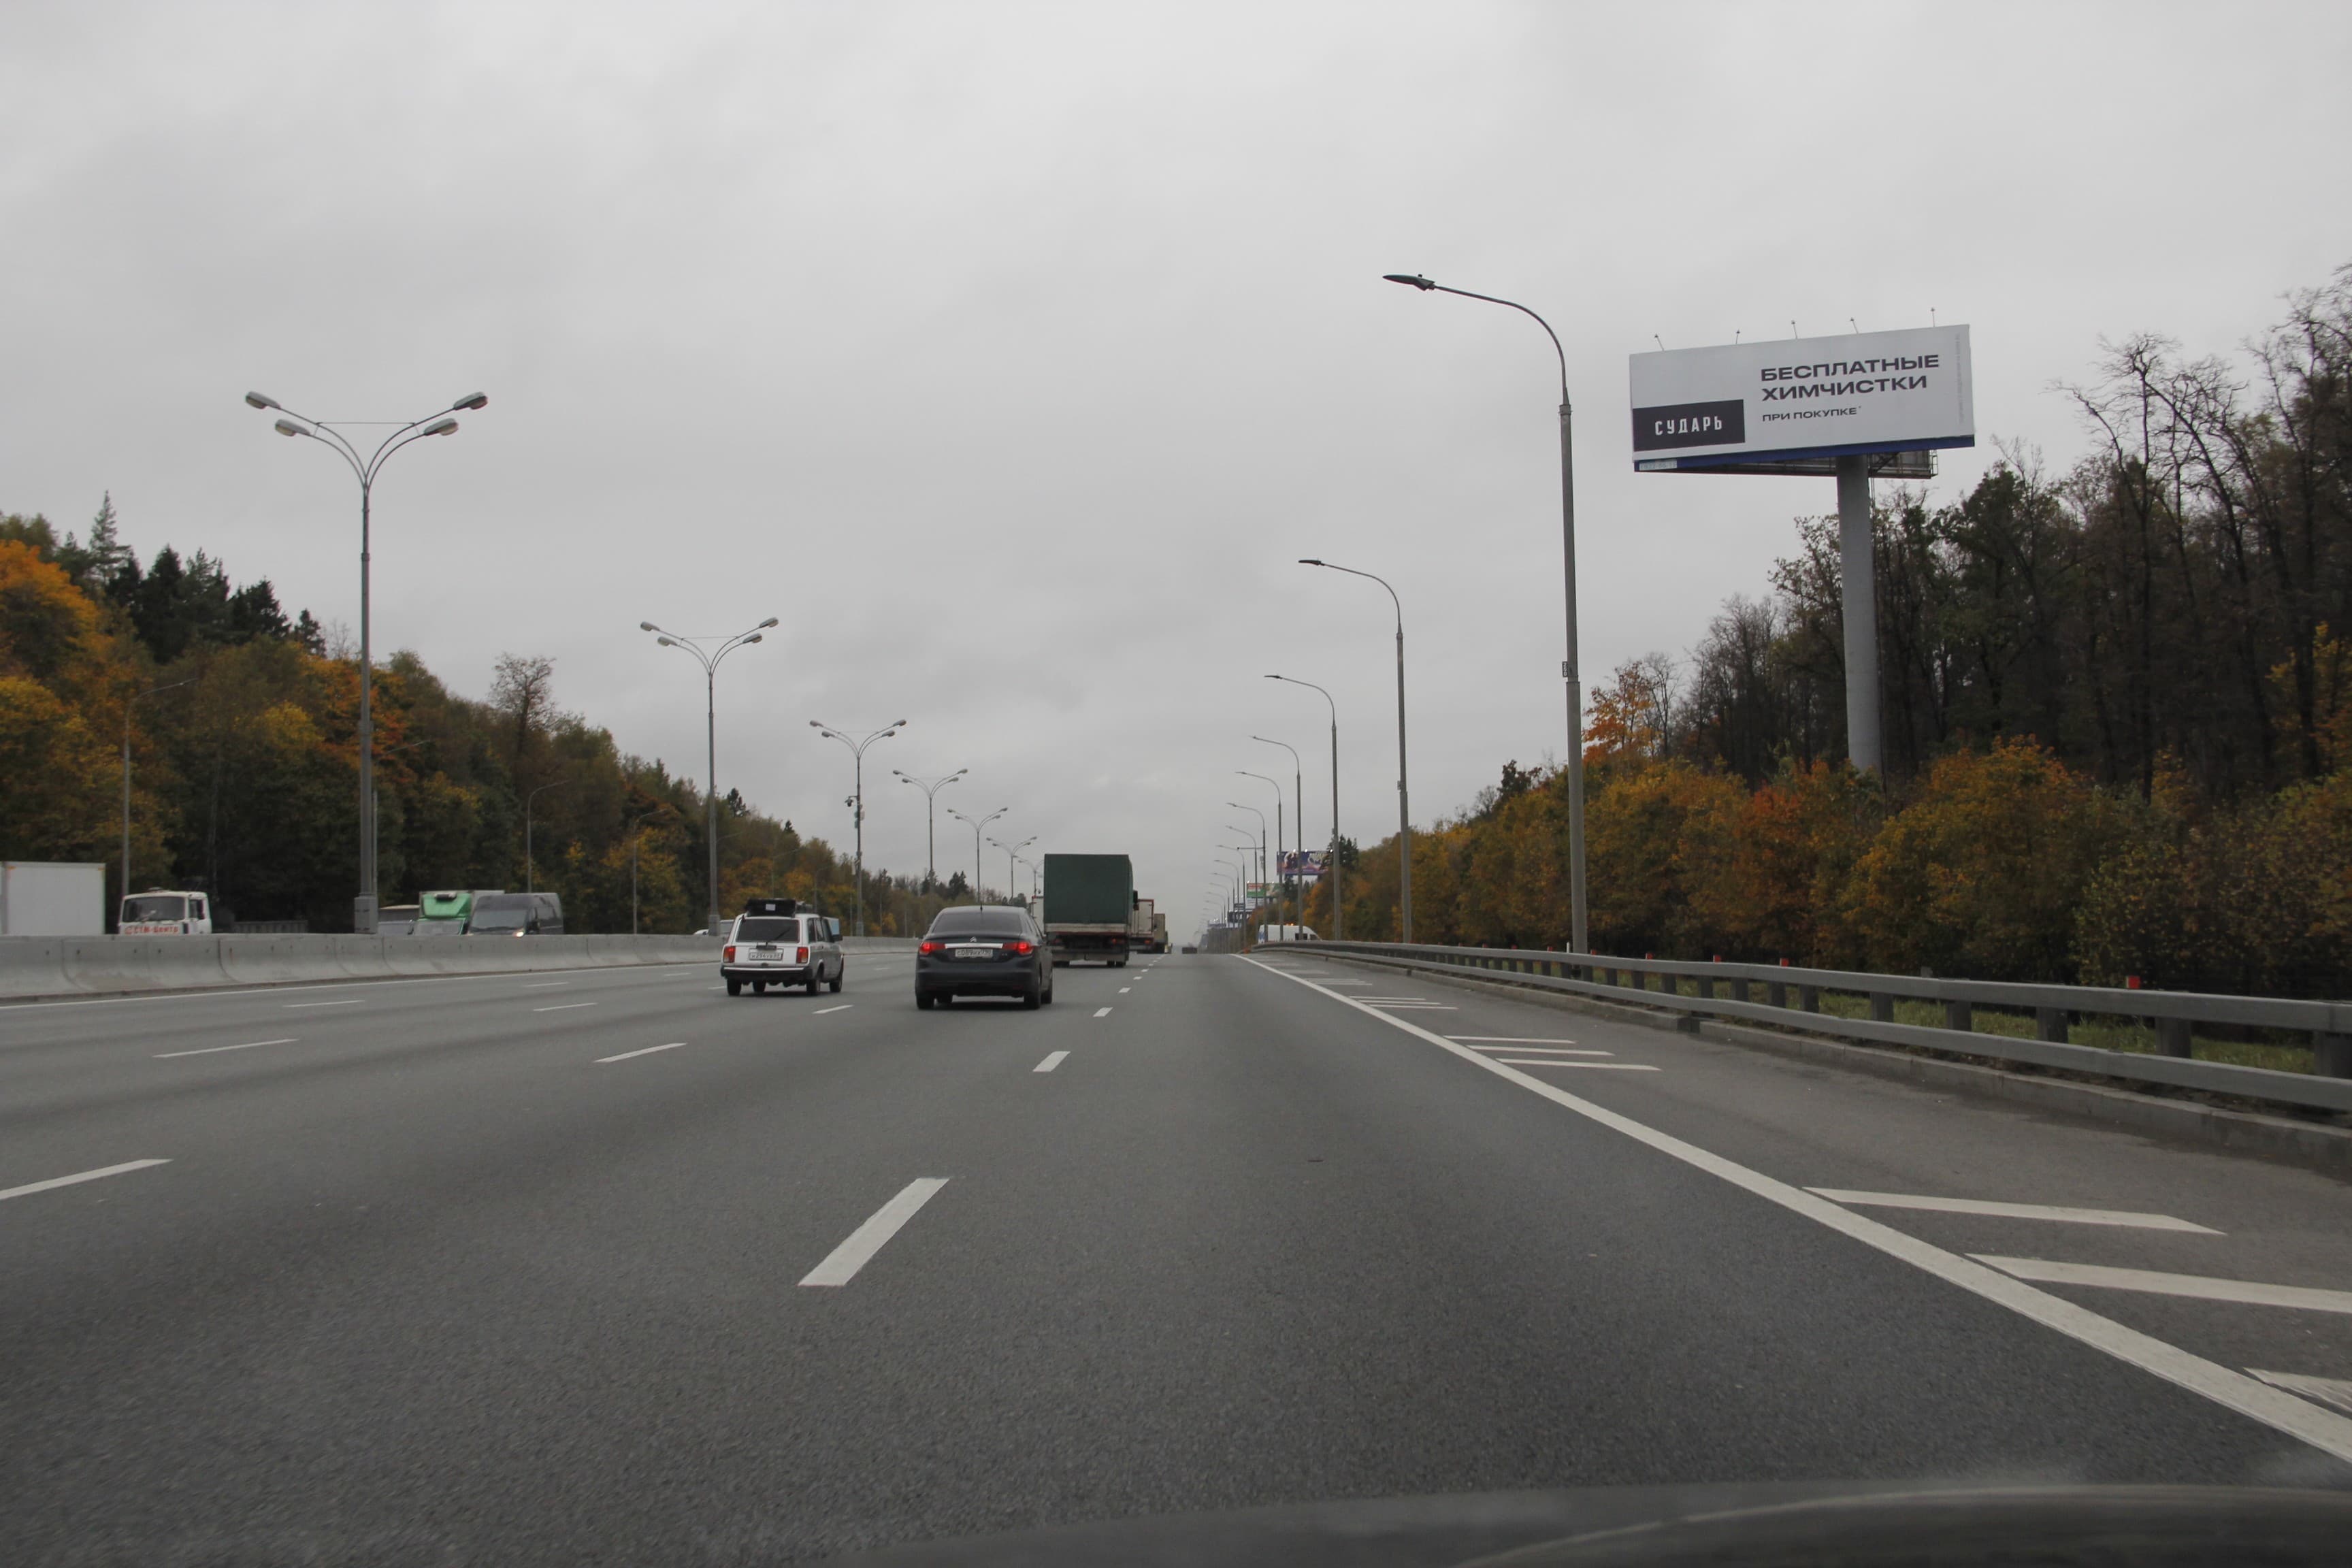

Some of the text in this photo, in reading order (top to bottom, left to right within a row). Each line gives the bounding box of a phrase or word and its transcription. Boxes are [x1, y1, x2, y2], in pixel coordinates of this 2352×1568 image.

[1761, 355, 1940, 382] БЕСПЛАТНЫЕ
[1761, 375, 1927, 402] ХИМЧИСТКИ
[1654, 416, 1722, 436] СУДАРЬ
[1762, 412, 1791, 422] ПРИ
